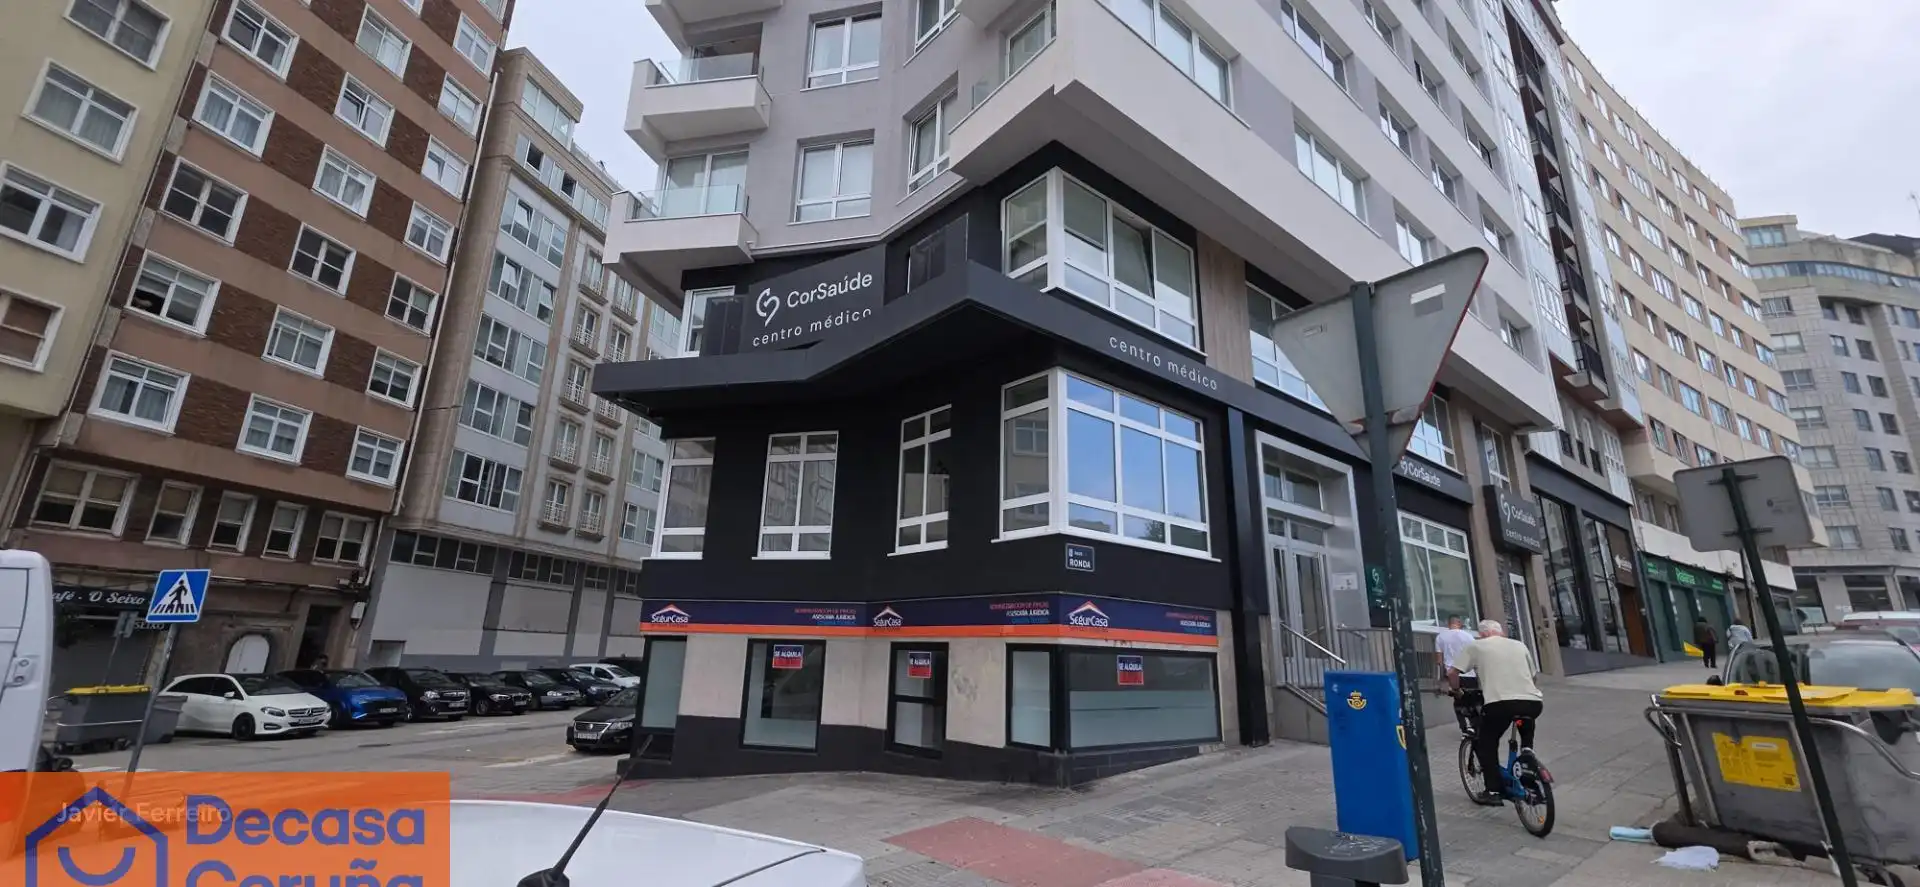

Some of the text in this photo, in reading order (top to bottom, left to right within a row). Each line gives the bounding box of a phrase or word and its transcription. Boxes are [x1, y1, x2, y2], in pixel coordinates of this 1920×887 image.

[787, 272, 873, 308] CorSaúde
[752, 326, 803, 347] centro
[1109, 336, 1218, 391] centro médico
[1408, 461, 1441, 487] CorSaúde
[1069, 558, 1092, 568] RONDA
[89, 590, 103, 602] O
[106, 591, 146, 605] Seixo
[651, 614, 689, 624] SegurCasa
[873, 616, 903, 627] SegurCasa
[1069, 613, 1109, 628] SegurCasa
